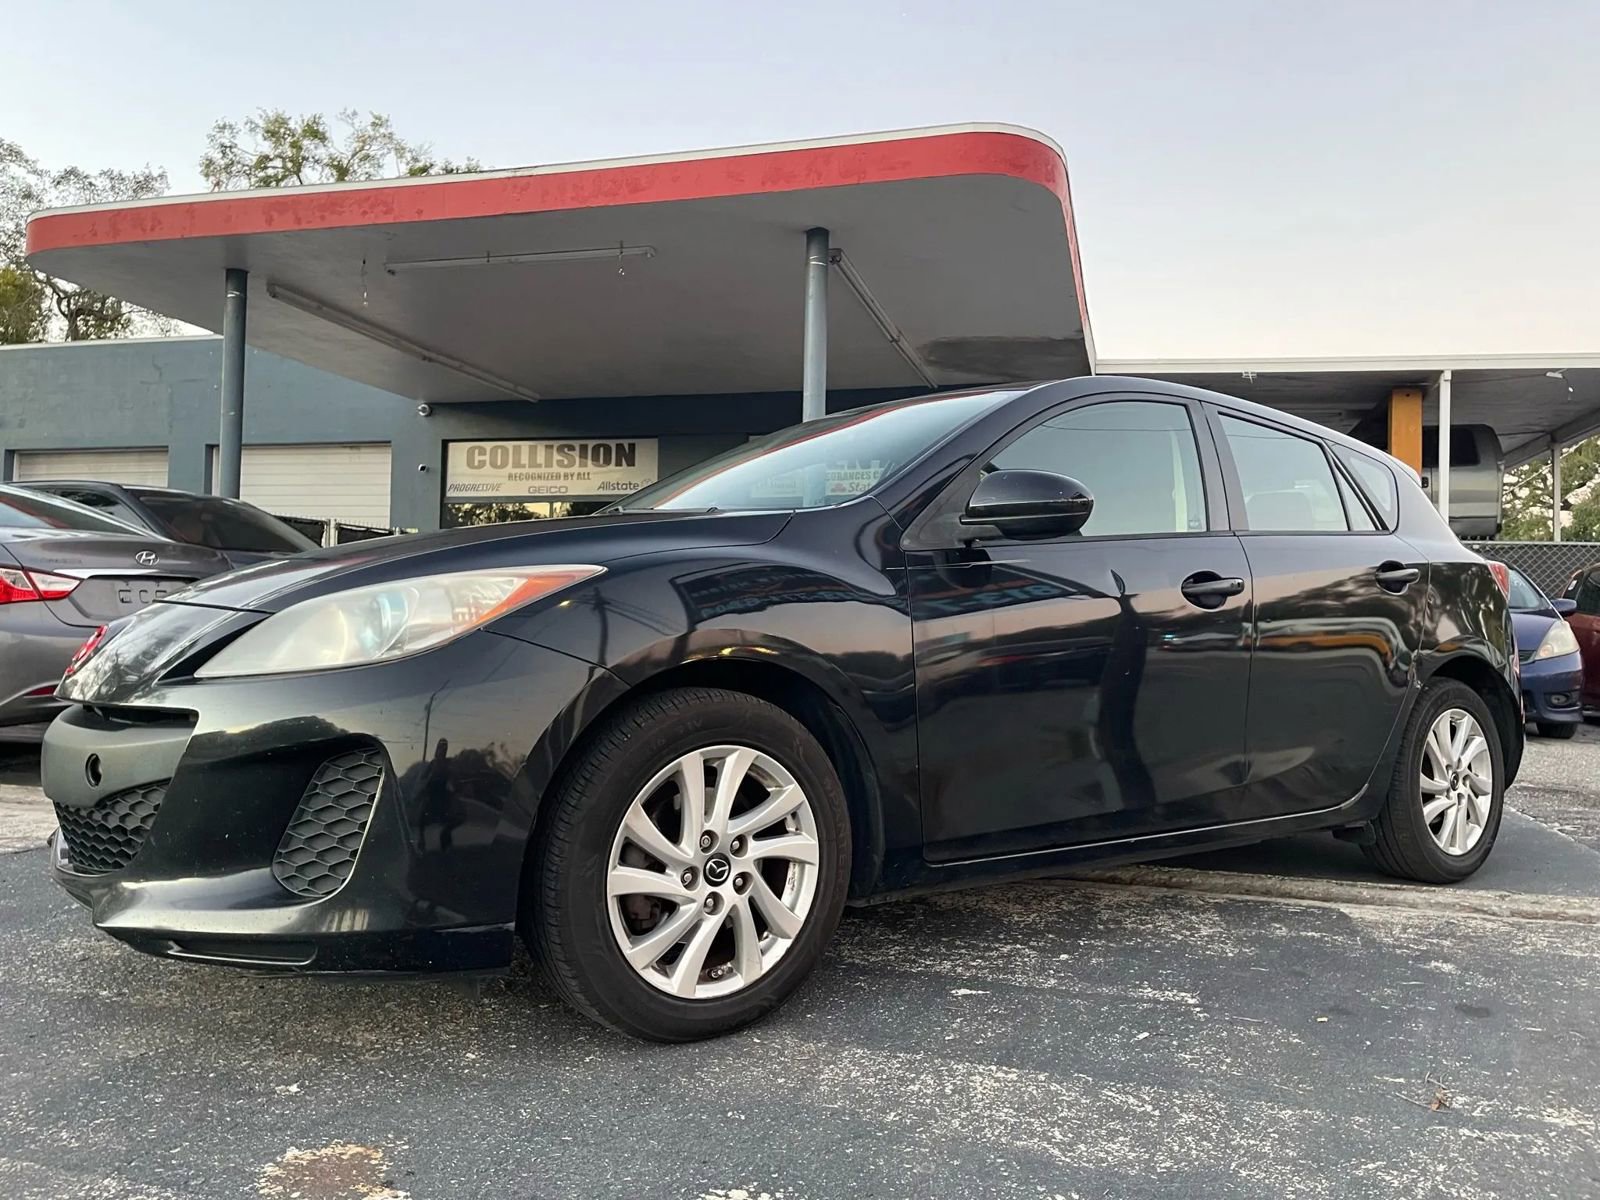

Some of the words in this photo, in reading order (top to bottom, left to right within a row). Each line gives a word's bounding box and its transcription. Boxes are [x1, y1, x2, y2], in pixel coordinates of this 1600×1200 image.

[466, 442, 636, 470] COLLISION
[508, 472, 561, 481] RECOGNIZED
[563, 472, 575, 481] BY
[576, 471, 592, 481] ALL
[448, 483, 502, 492] PROGRESSIVE
[528, 485, 568, 494] GEICO
[597, 480, 640, 491] Allstate
